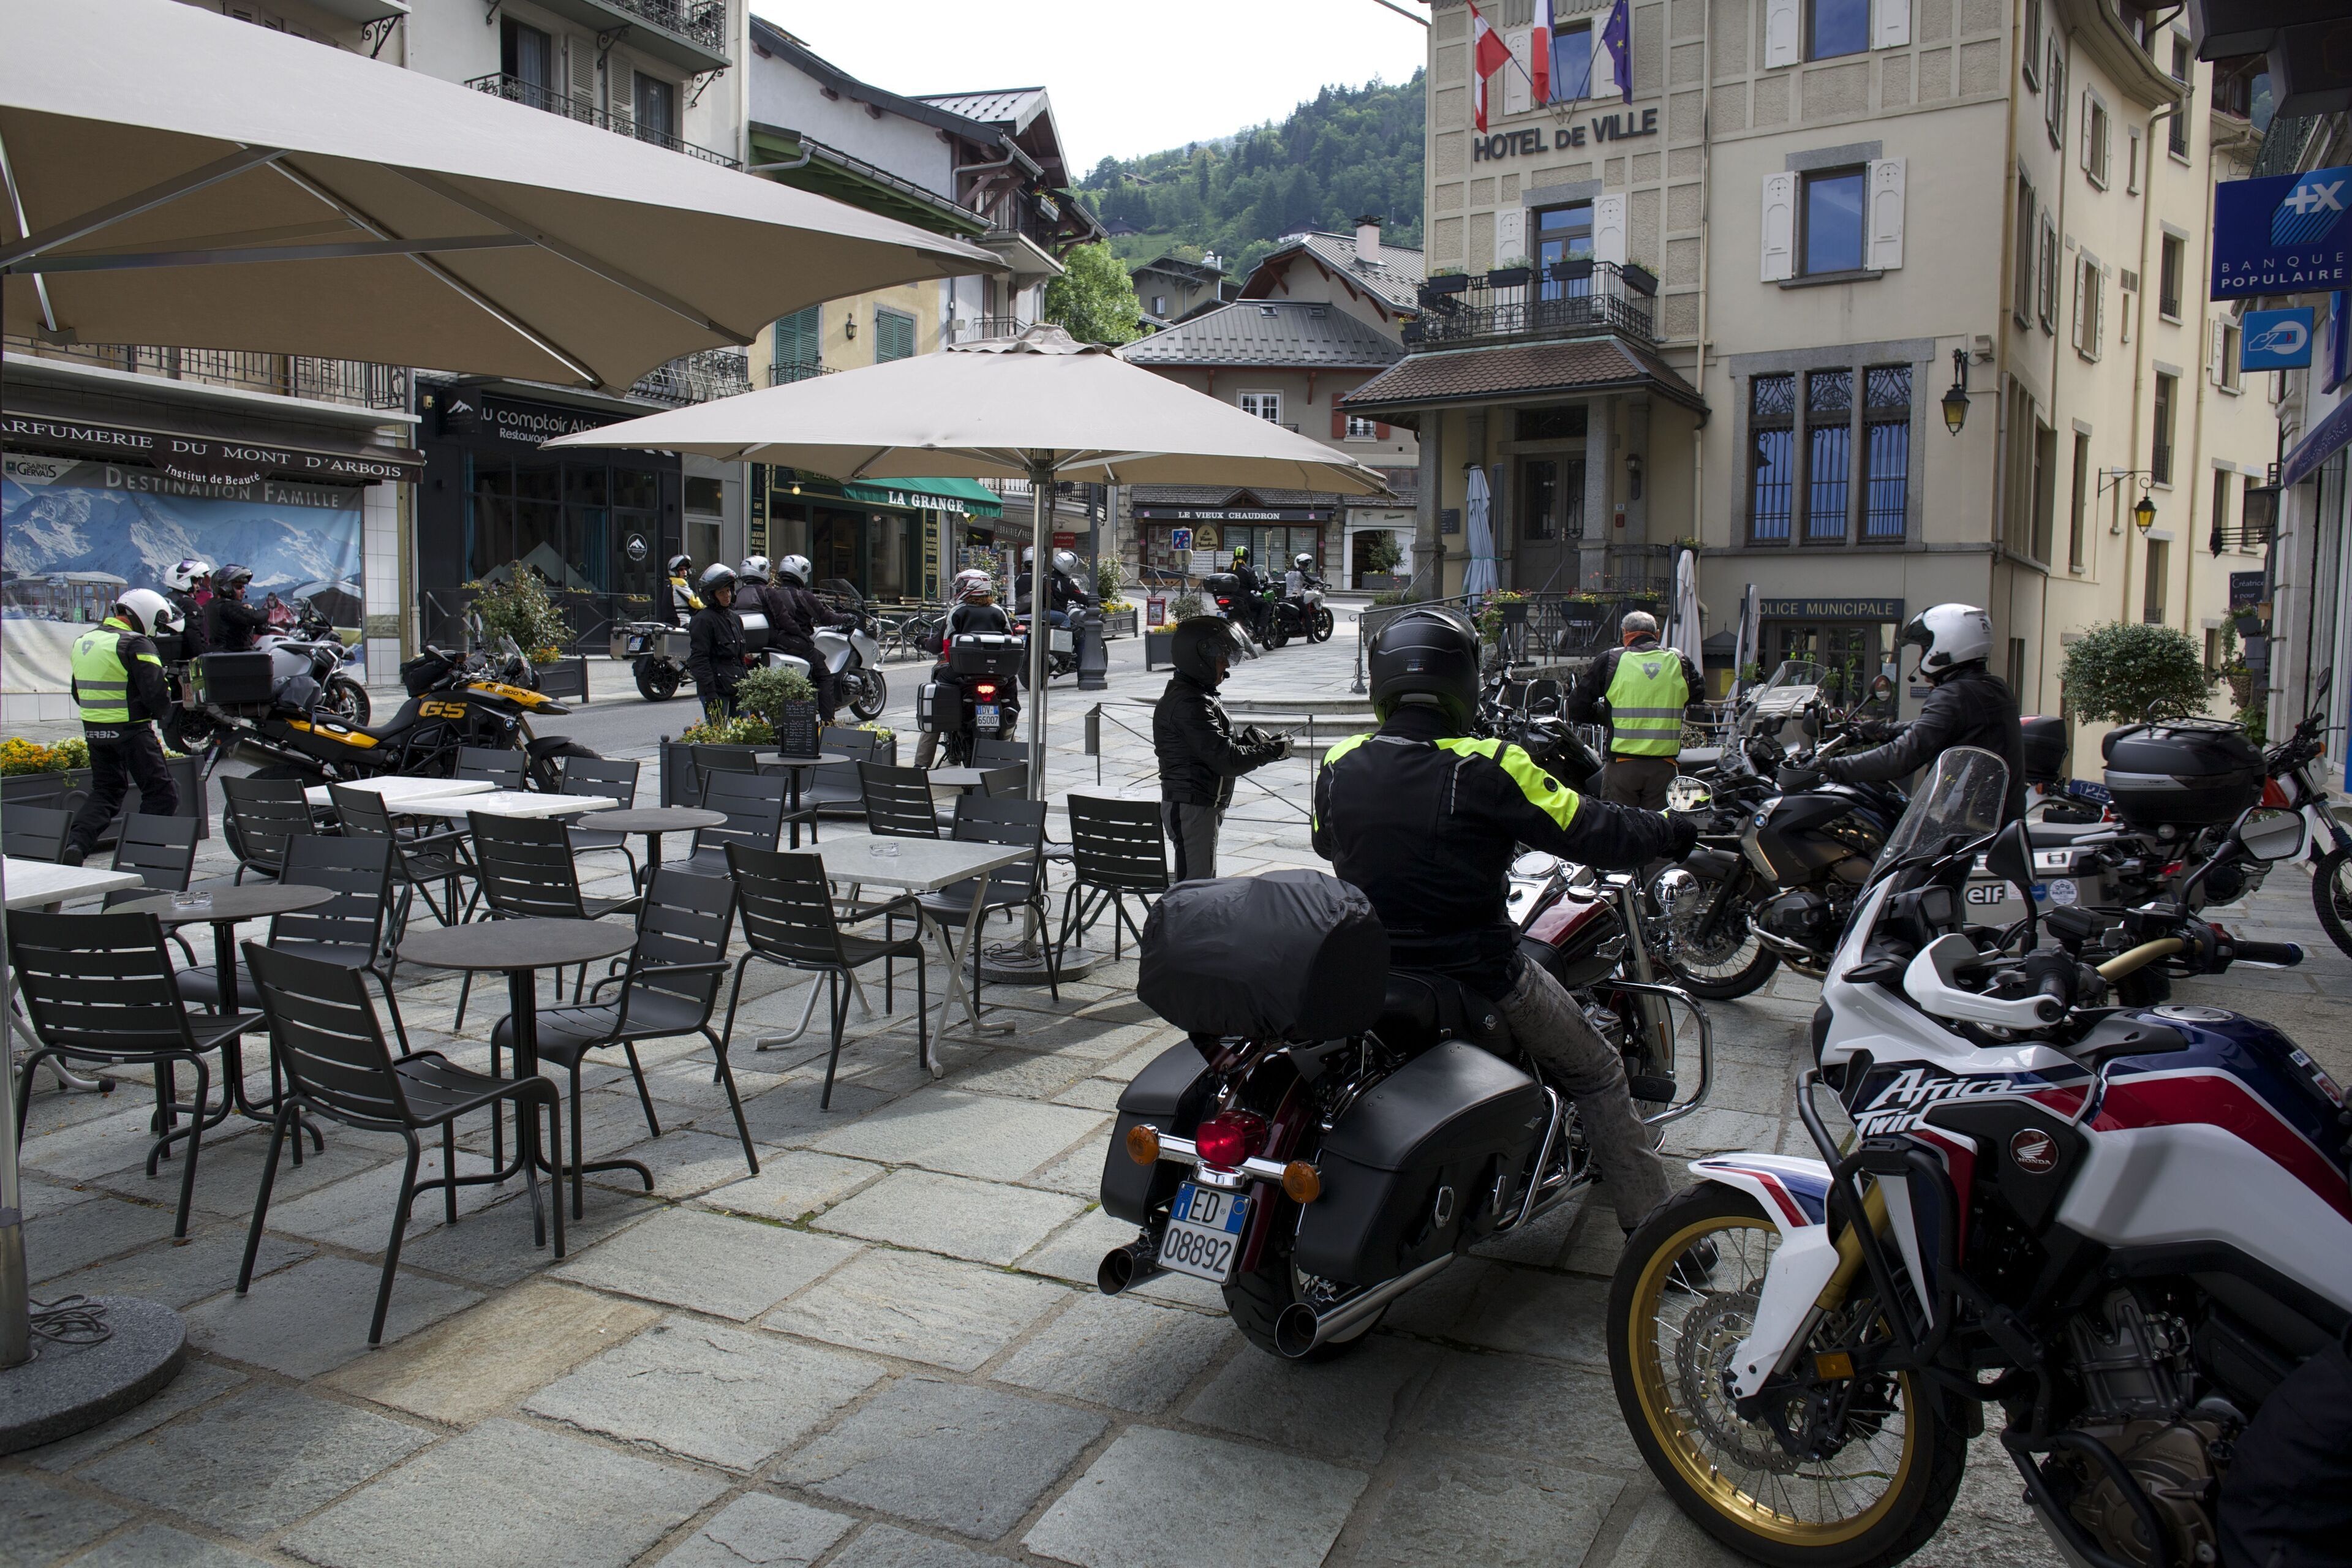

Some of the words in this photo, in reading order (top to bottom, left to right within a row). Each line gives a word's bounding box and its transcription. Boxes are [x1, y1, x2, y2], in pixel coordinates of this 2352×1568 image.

[1474, 128, 1548, 162] HOTEL
[1555, 126, 1585, 149] DE
[1592, 108, 1657, 143] VILLE
[2222, 252, 2344, 273] BANQUE
[2222, 269, 2343, 288] POPULAIRE
[497, 410, 567, 432] comptoir
[499, 428, 548, 443] Restaurant
[2, 420, 153, 448] RFUMERIE
[172, 440, 208, 454] DU
[222, 447, 290, 464] MONT
[306, 456, 401, 477] D'ARBOIS
[17, 462, 56, 478] GERVAIS
[165, 464, 206, 483] Institut
[210, 474, 222, 484] de
[225, 472, 260, 486] Beauté
[106, 466, 250, 500] DESTINATION
[265, 483, 337, 507] FAMILLE
[888, 491, 906, 505] LA
[911, 494, 963, 512] GRANGE
[2233, 578, 2264, 588] Créatrice
[1760, 603, 1798, 614] OLICE
[1807, 603, 1893, 616] MUNICIPALE
[419, 701, 468, 718] GS
[978, 716, 998, 725] 65007
[2079, 783, 2111, 801] 125
[1967, 886, 2003, 903] elf
[1865, 1068, 2021, 1110] Africa
[1853, 1107, 1923, 1136] Twin
[1189, 1190, 1221, 1223] ED
[1164, 1227, 1232, 1273] 08892
